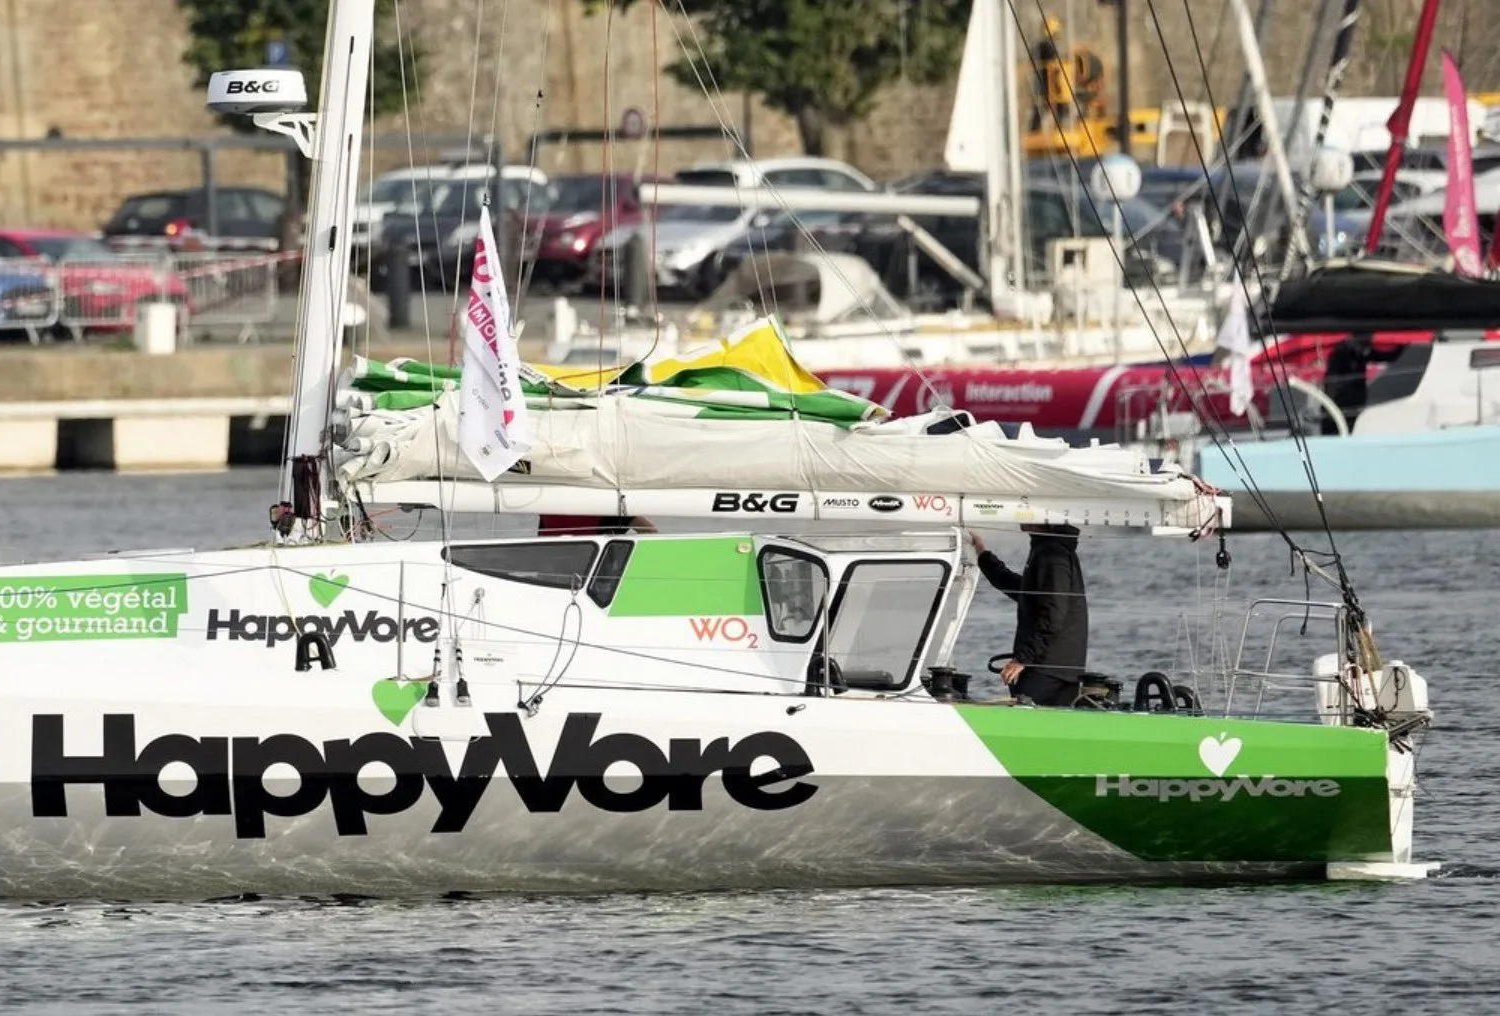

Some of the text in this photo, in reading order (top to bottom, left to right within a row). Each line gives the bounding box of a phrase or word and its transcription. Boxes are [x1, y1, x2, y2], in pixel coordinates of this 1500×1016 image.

[226, 80, 280, 95] B&G
[965, 381, 1052, 403] Interaction
[711, 492, 800, 513] B&G
[823, 499, 860, 507] MUSTO
[67, 586, 178, 615] végétal
[15, 612, 170, 640] gourmand
[206, 608, 440, 648] HappyVore
[689, 617, 758, 649] WO2
[31, 712, 818, 839] HappyVore
[1095, 773, 1342, 802] HappyVore
